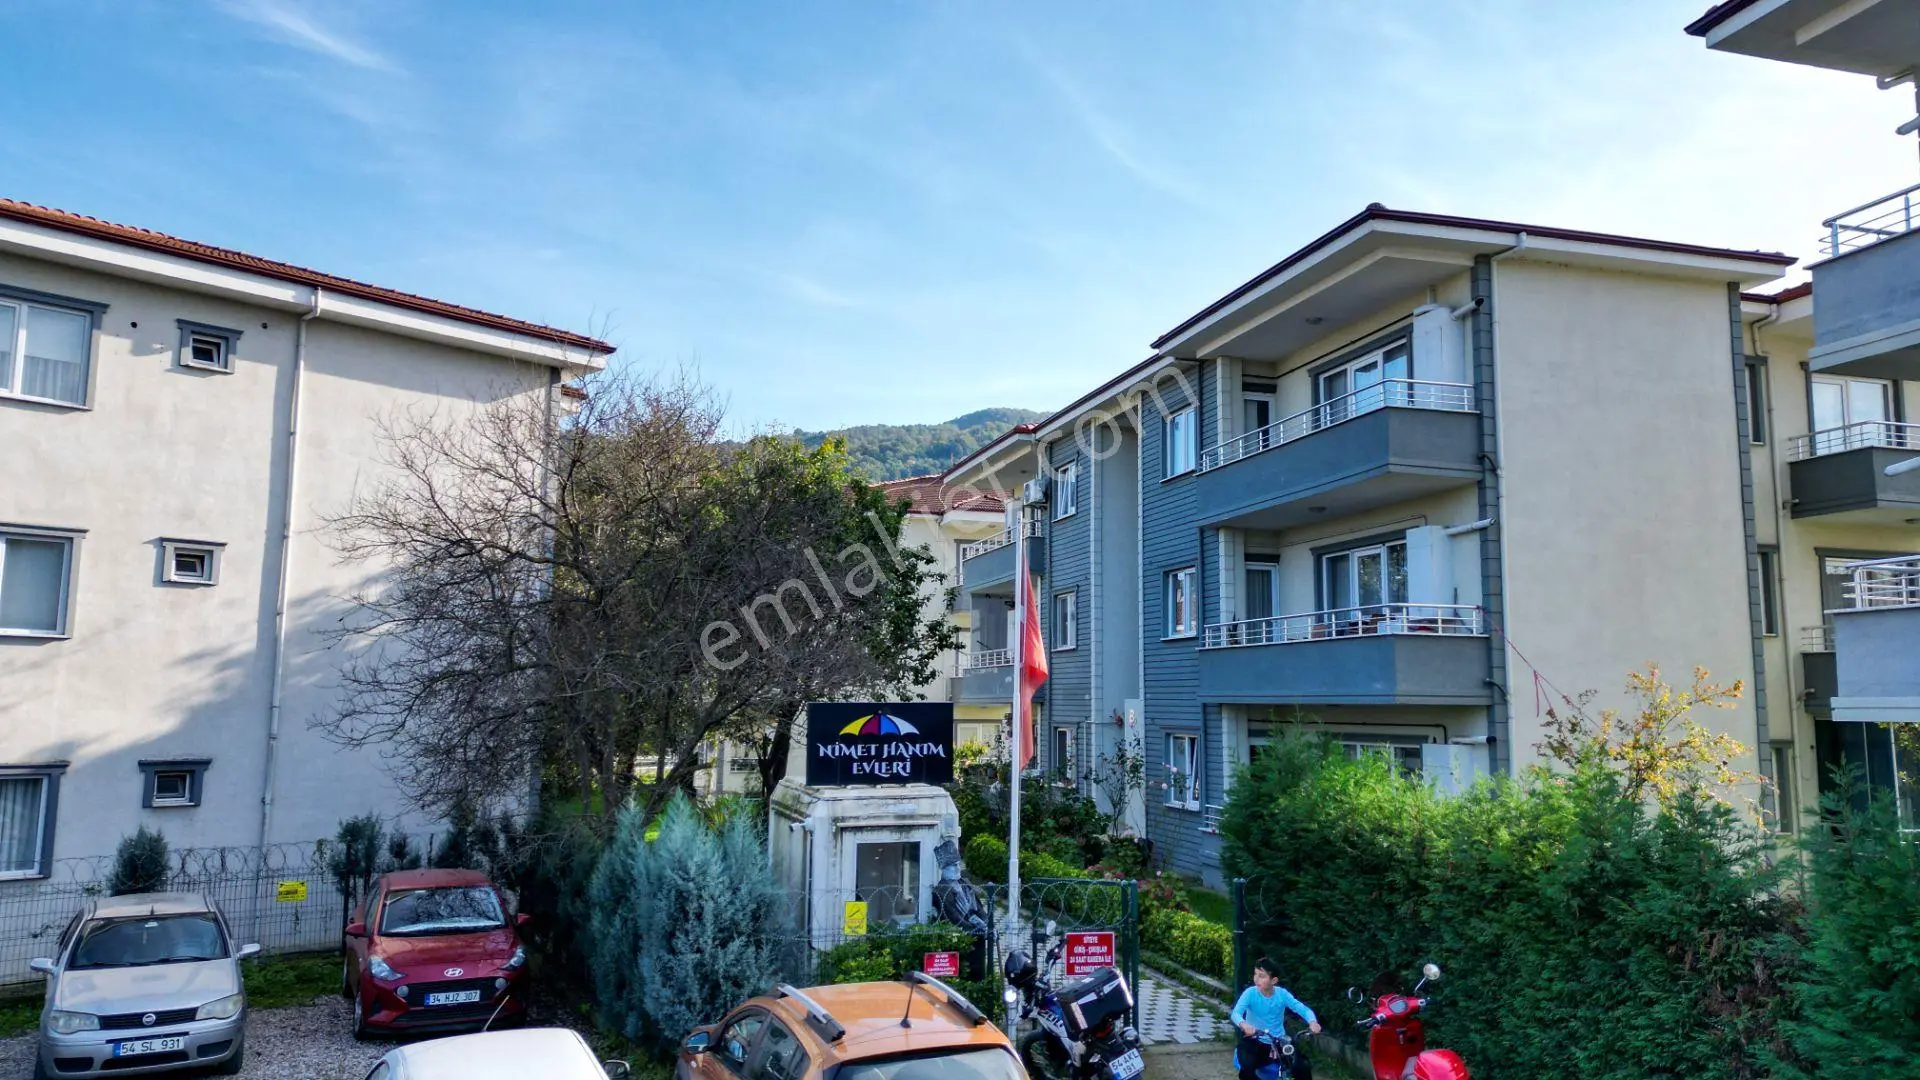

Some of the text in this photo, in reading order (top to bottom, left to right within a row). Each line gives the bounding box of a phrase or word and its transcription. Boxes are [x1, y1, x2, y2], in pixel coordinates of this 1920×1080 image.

[817, 741, 946, 759] NİMET HANIM
[852, 759, 911, 777] EVLERİ
[431, 995, 440, 1003] 34
[121, 1038, 180, 1054] 54 SL 931
[1112, 1051, 1139, 1070] 54 AKL
[1123, 1063, 1136, 1074] 191
